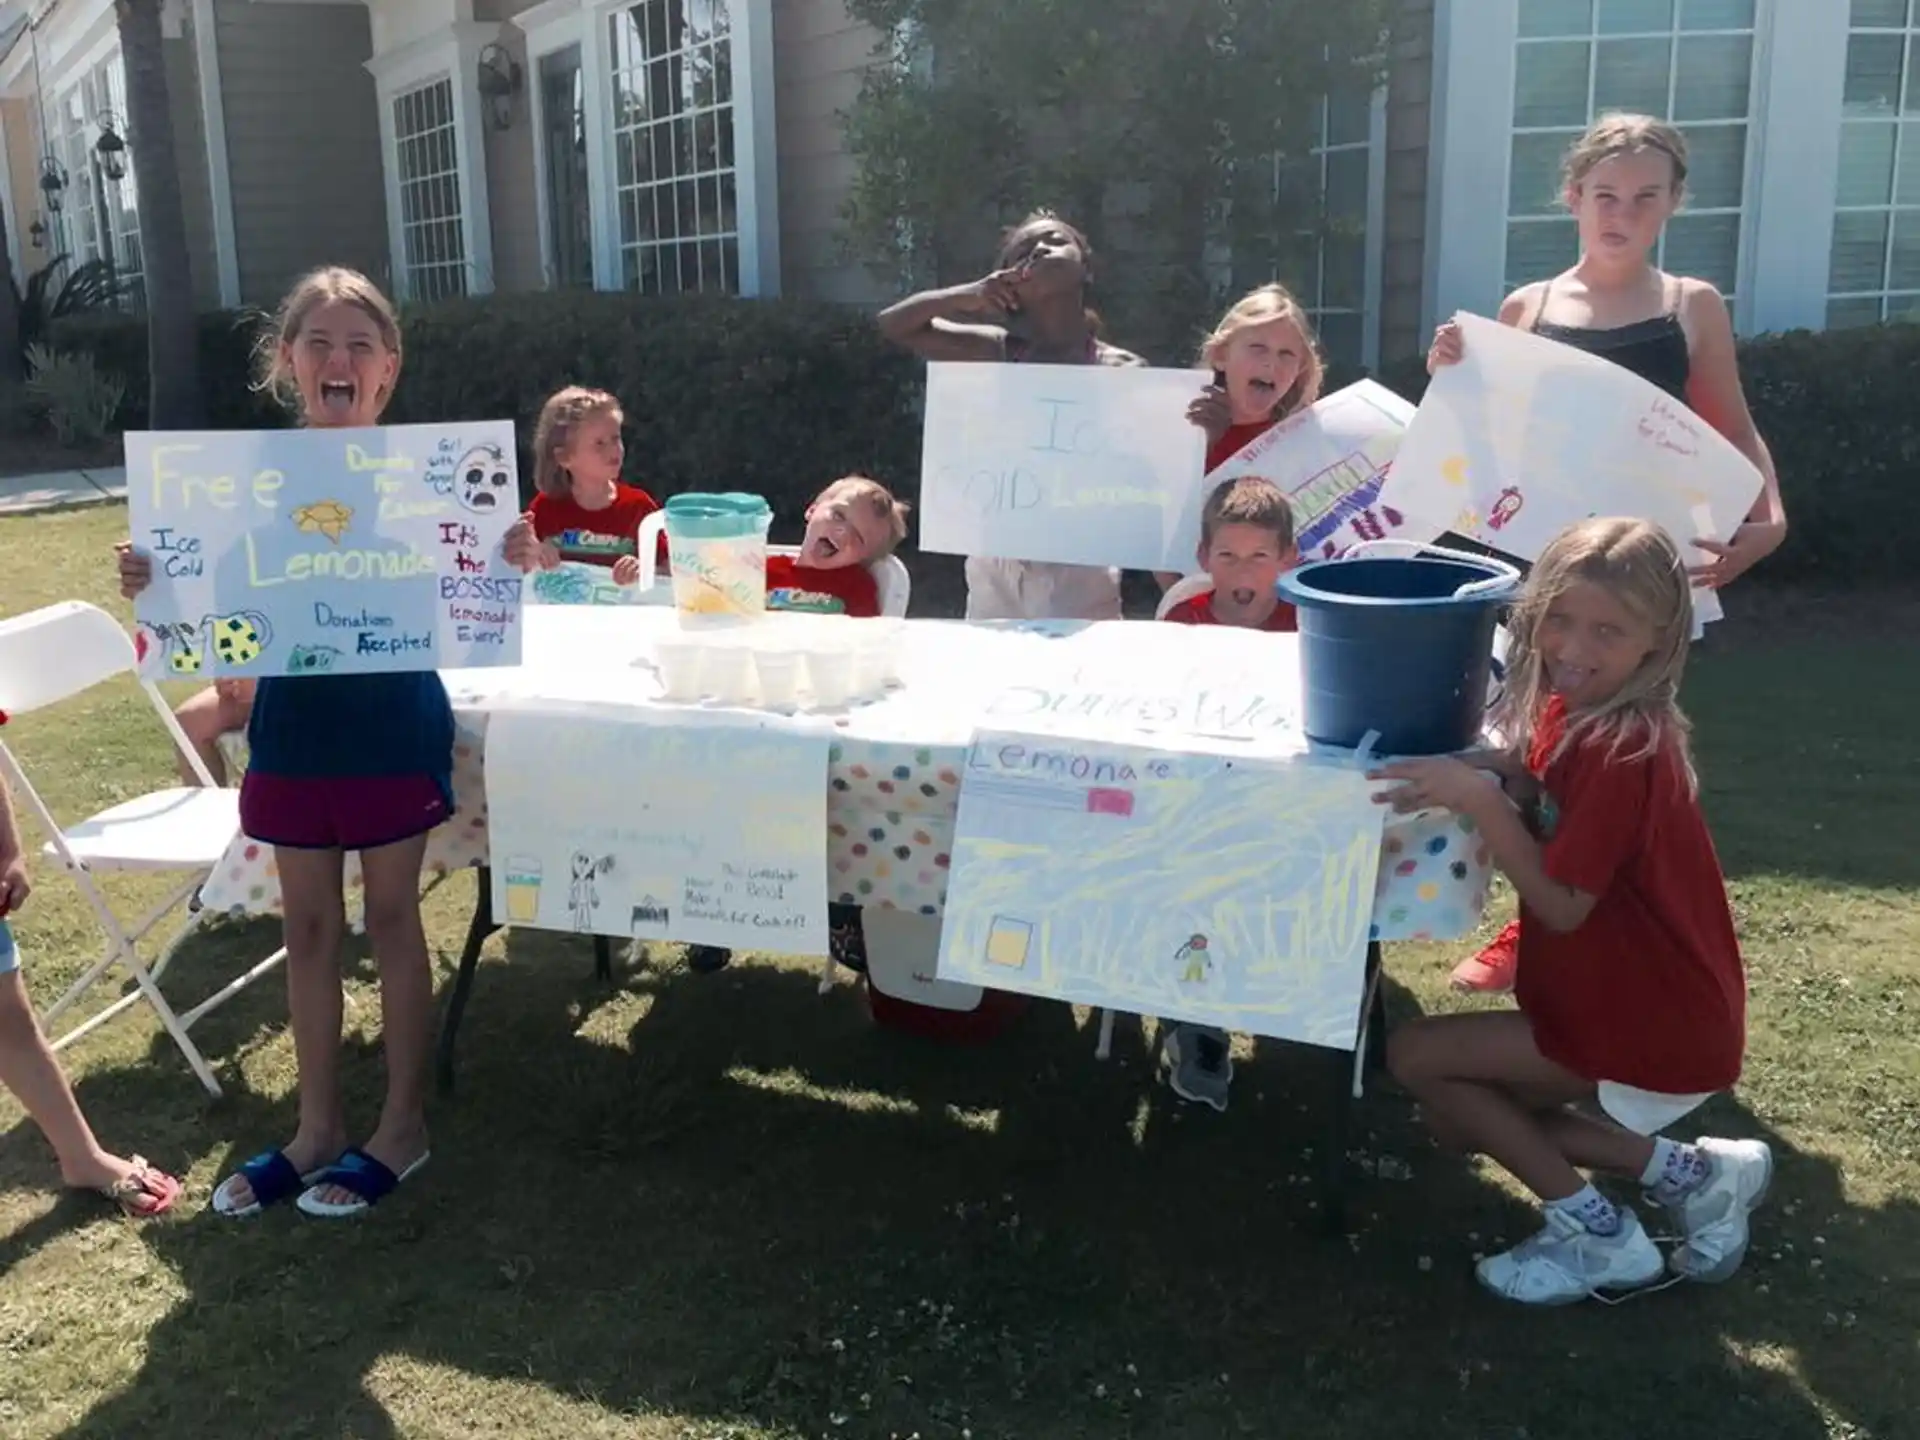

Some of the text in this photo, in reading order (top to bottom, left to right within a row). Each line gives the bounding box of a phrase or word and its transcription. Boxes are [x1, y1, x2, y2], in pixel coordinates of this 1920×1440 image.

[152, 444, 285, 510] Free
[151, 528, 201, 552] Ice
[439, 523, 479, 547] It's
[165, 556, 204, 578] Cold
[245, 531, 436, 587] Lemonade
[455, 552, 486, 575] the
